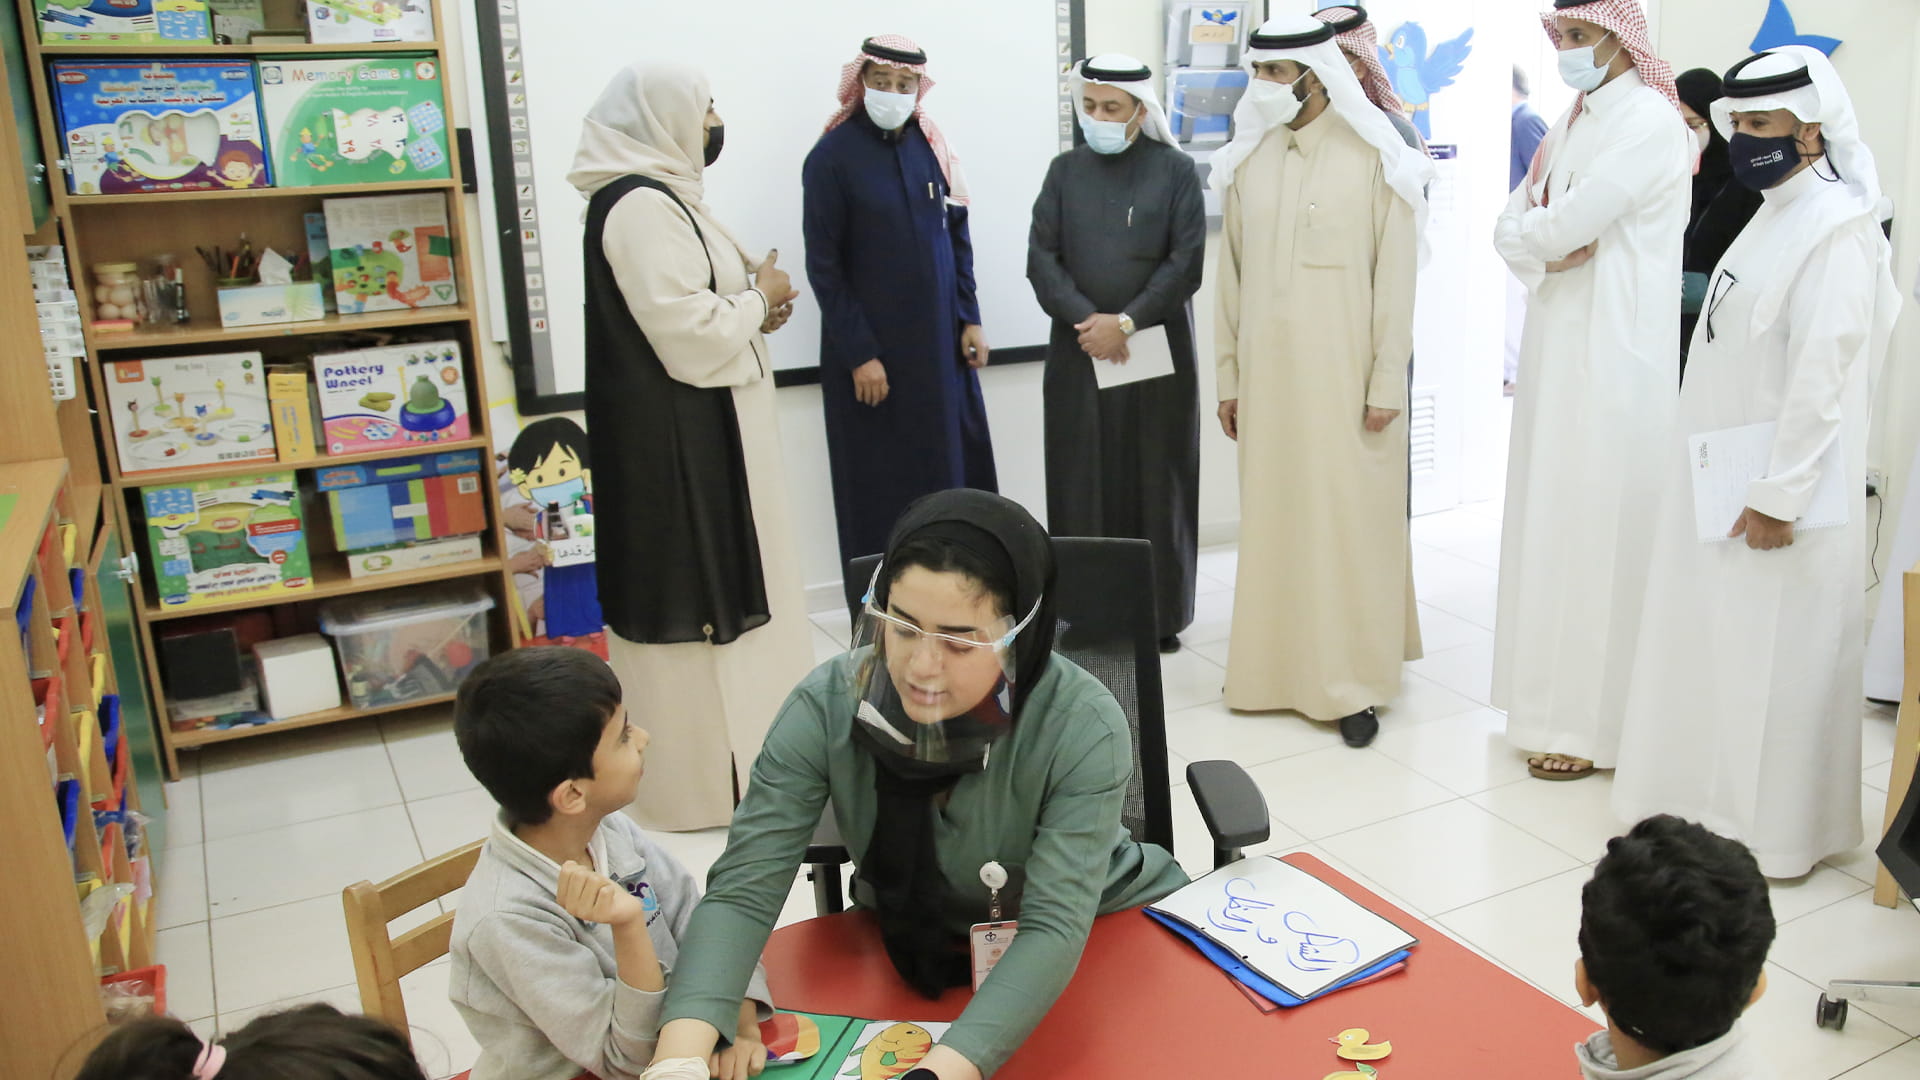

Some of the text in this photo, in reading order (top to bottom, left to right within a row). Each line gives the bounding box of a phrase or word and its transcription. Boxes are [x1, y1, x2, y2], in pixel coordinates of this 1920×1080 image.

[292, 68, 353, 85] Memory
[358, 65, 401, 81] Game
[323, 364, 384, 378] Pottery
[1206, 877, 1360, 972] الشكل و الظل
